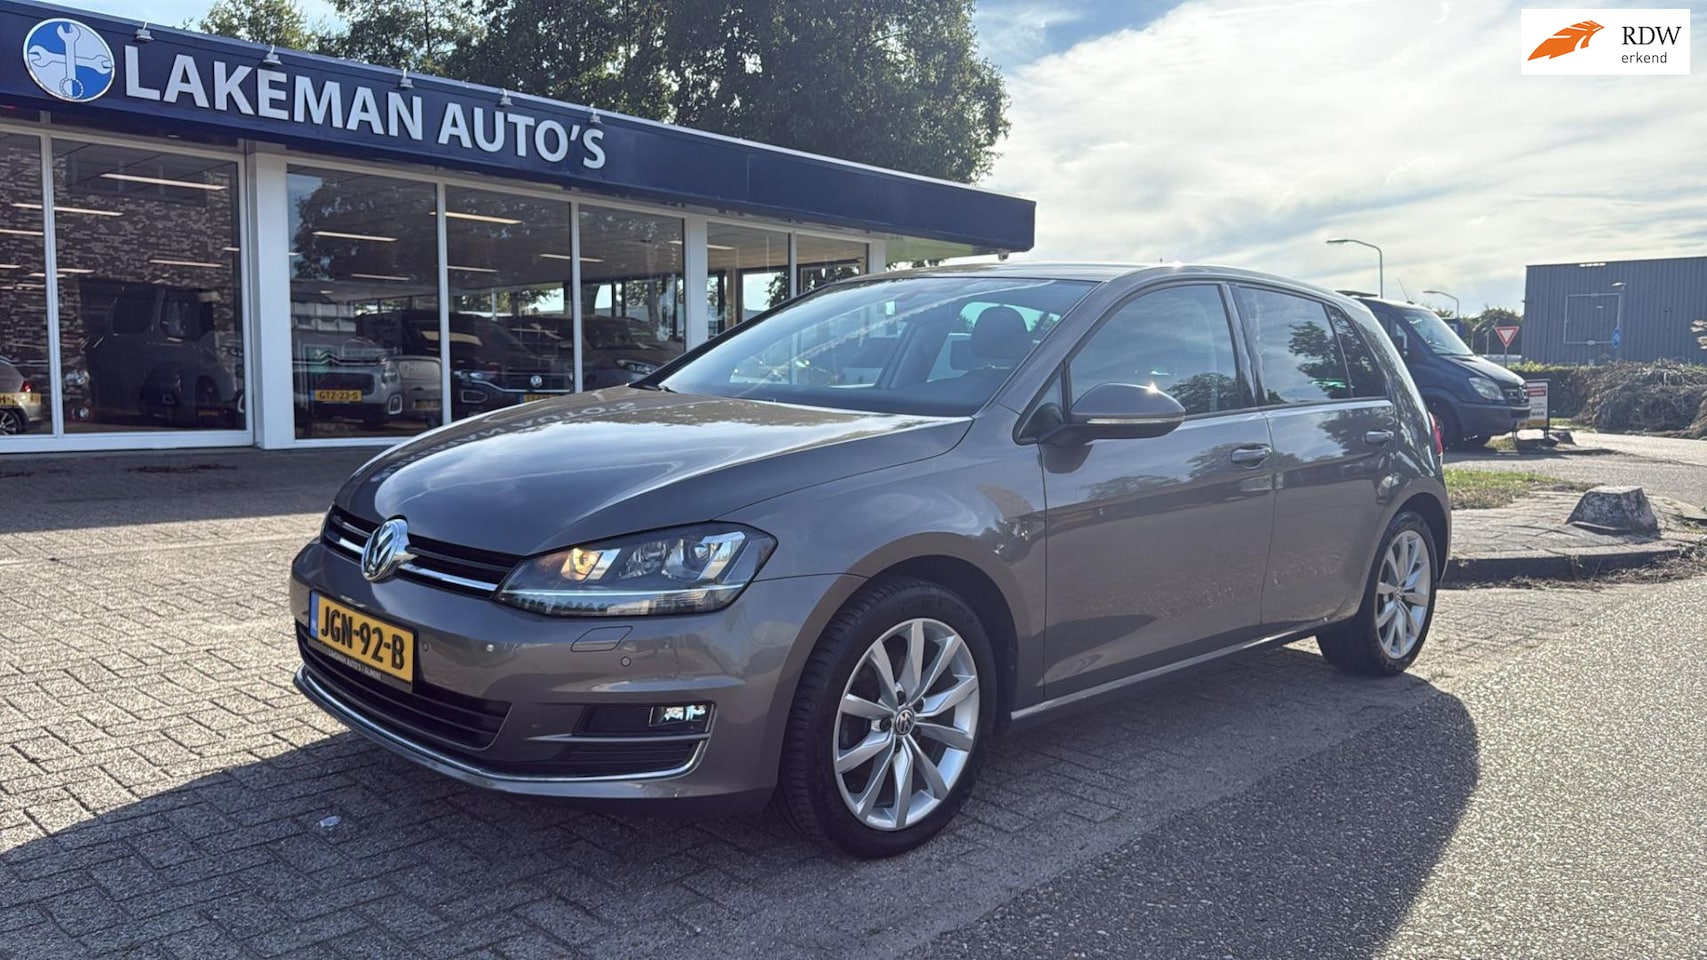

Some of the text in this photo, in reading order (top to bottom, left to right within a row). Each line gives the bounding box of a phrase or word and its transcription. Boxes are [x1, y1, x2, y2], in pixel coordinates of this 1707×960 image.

[124, 44, 606, 170] LAKEMAN AUTO'S
[321, 606, 405, 670] JGN-92-B
